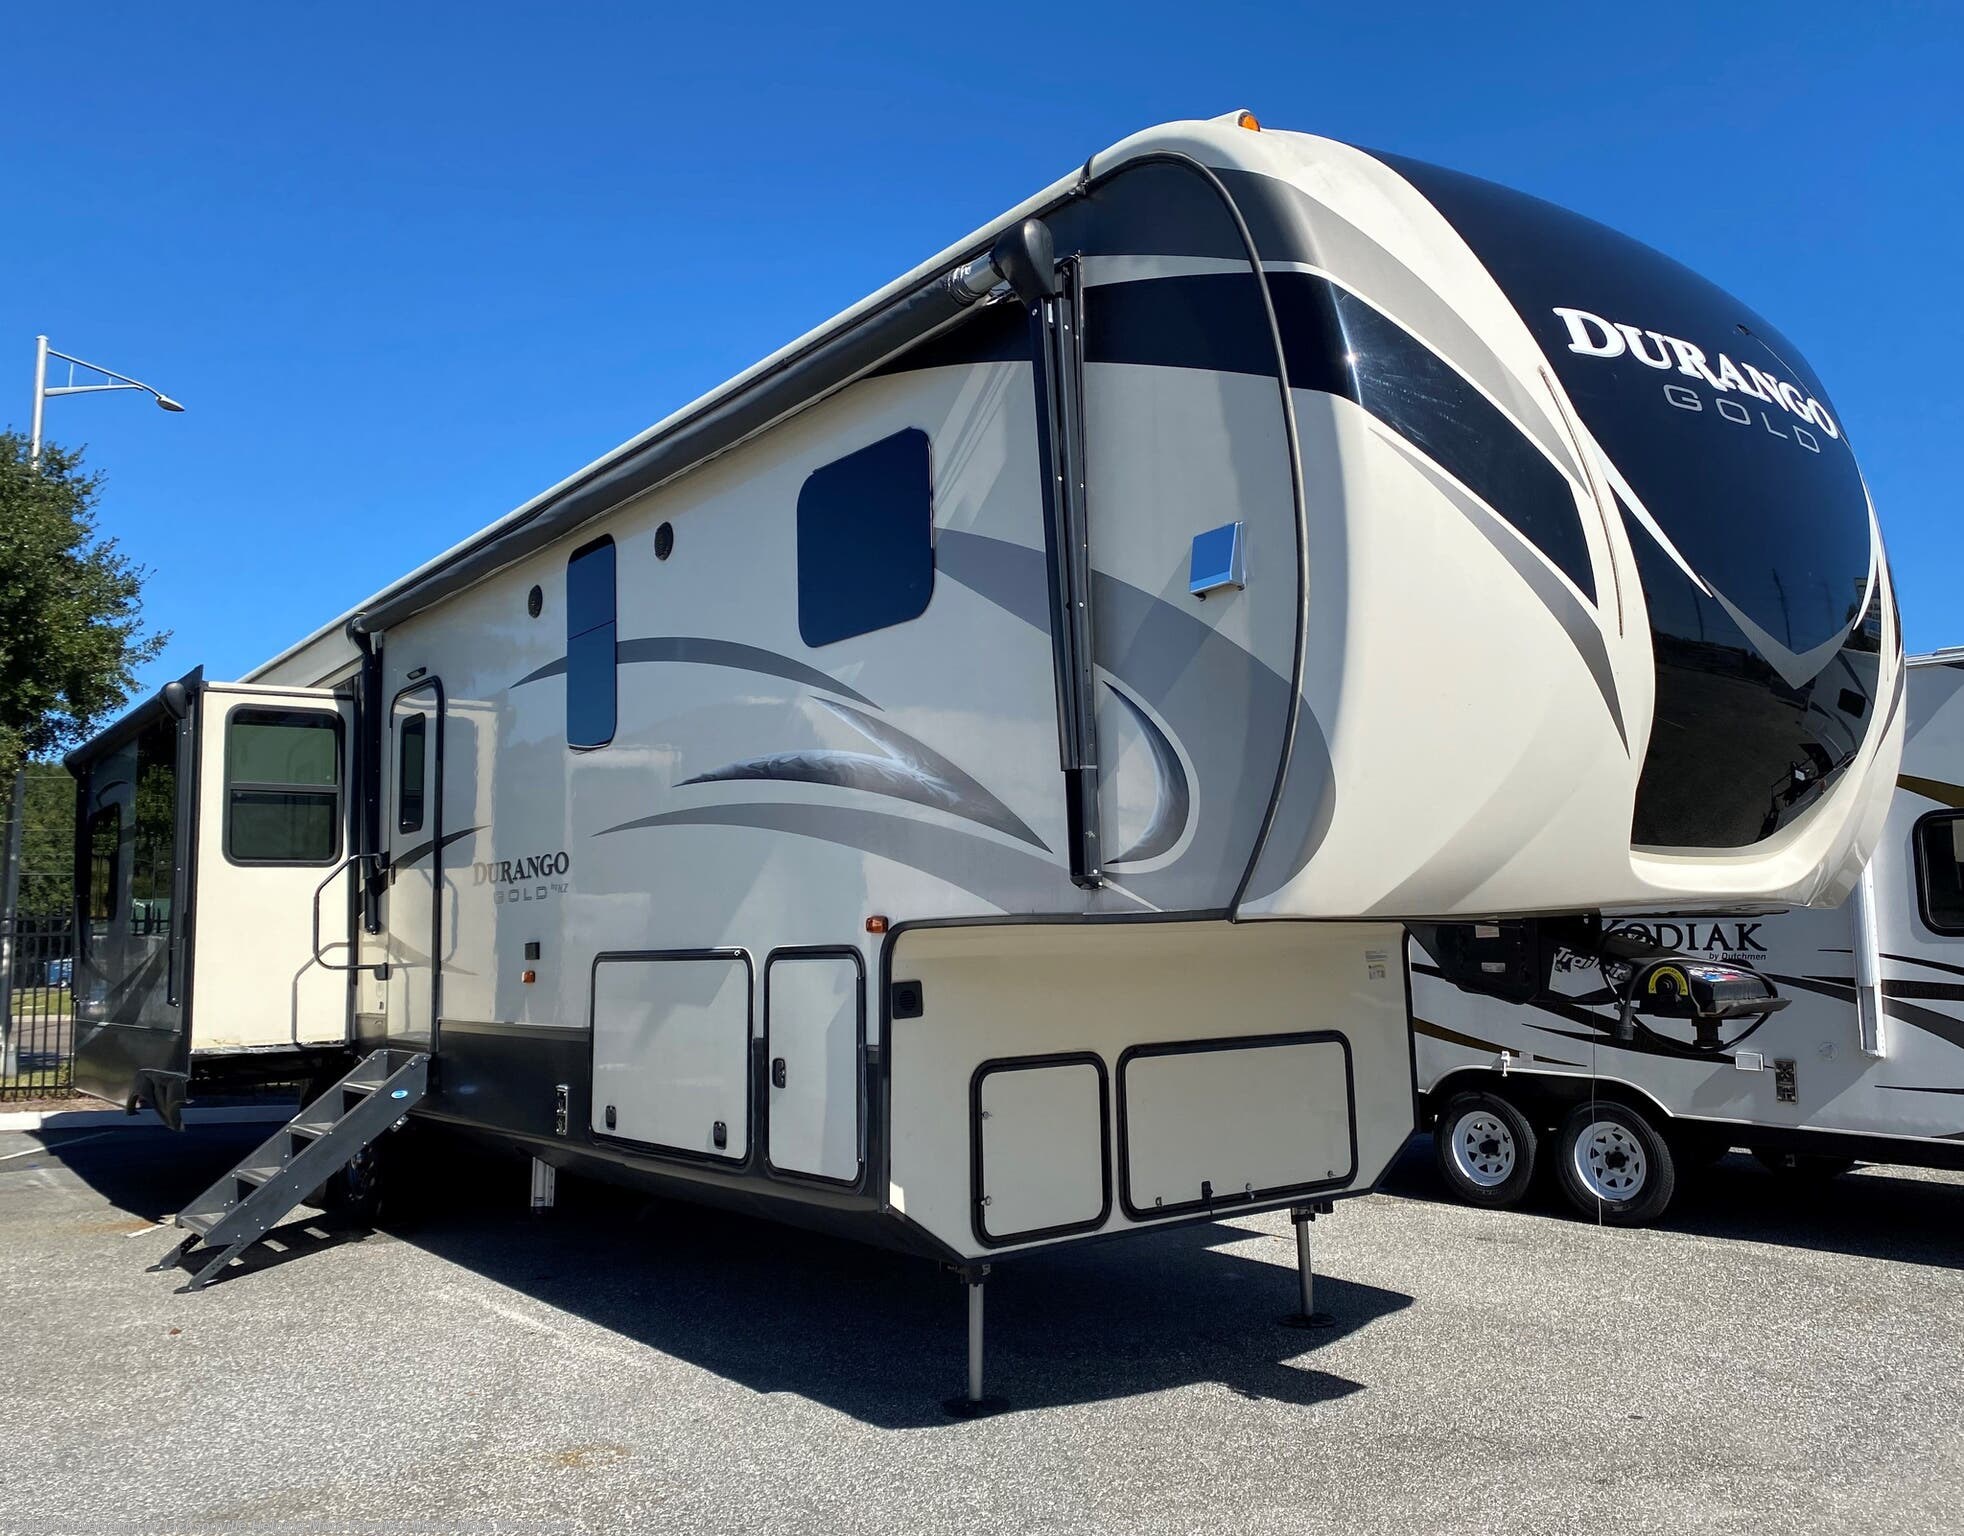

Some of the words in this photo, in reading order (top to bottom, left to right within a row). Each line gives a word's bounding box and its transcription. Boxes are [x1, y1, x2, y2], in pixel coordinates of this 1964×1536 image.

[1552, 306, 1840, 440] DURANGO
[1663, 384, 1821, 453] GOLD
[473, 852, 570, 886] DURANGO
[494, 886, 548, 905] GOLD
[1709, 952, 1719, 962] by
[1721, 952, 1767, 961] Dutchmen
